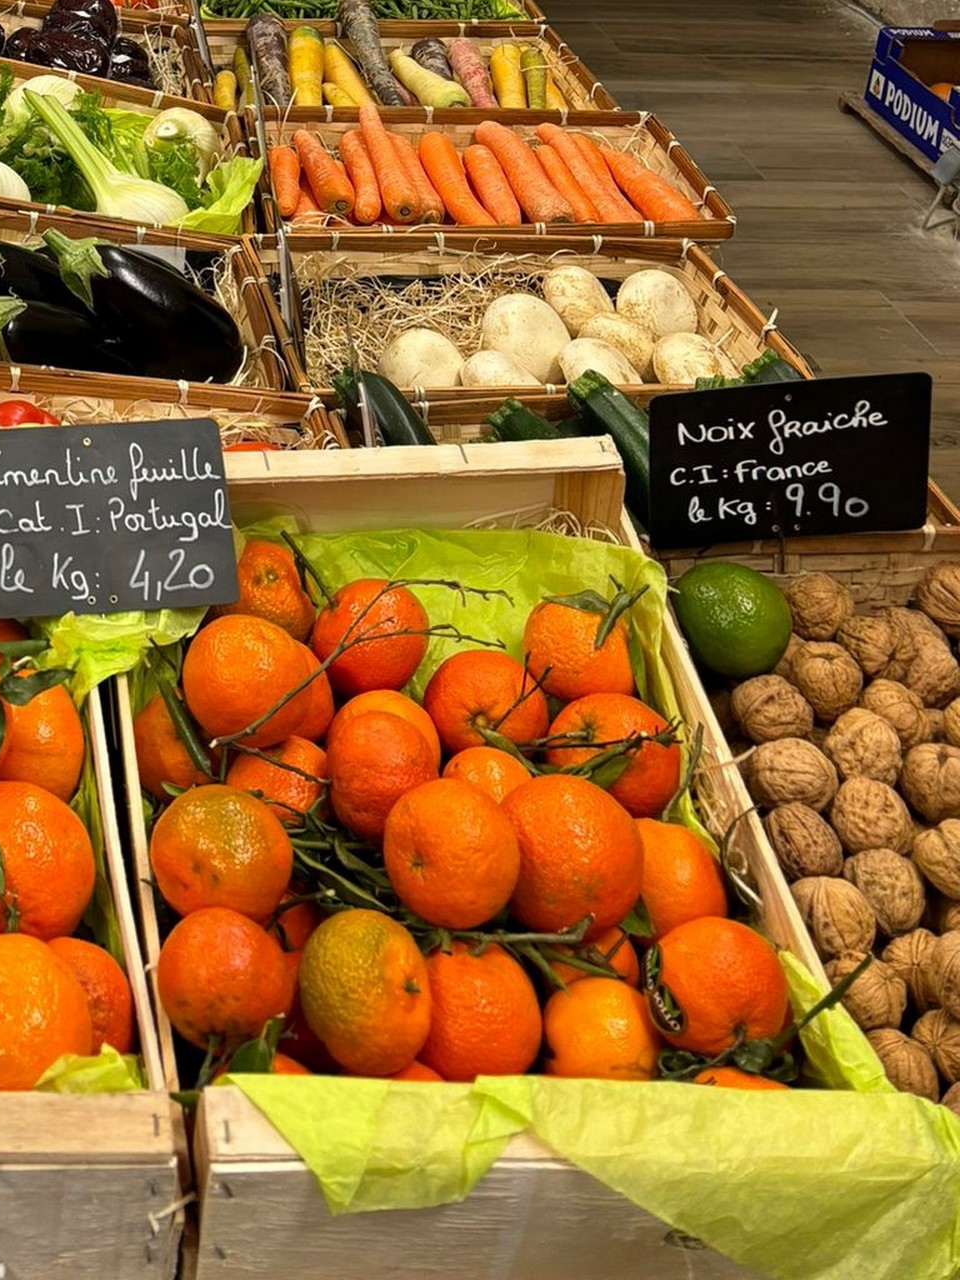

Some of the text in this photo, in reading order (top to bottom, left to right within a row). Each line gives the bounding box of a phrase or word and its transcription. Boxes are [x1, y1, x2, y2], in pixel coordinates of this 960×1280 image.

[884, 80, 940, 148] PODIUM
[677, 417, 756, 446] Noix
[129, 442, 222, 500] feuille
[108, 489, 233, 542] Portugal
[688, 495, 713, 524] le
[785, 482, 870, 519] 9.90
[0, 543, 34, 594] le
[129, 548, 215, 602] 4,20
